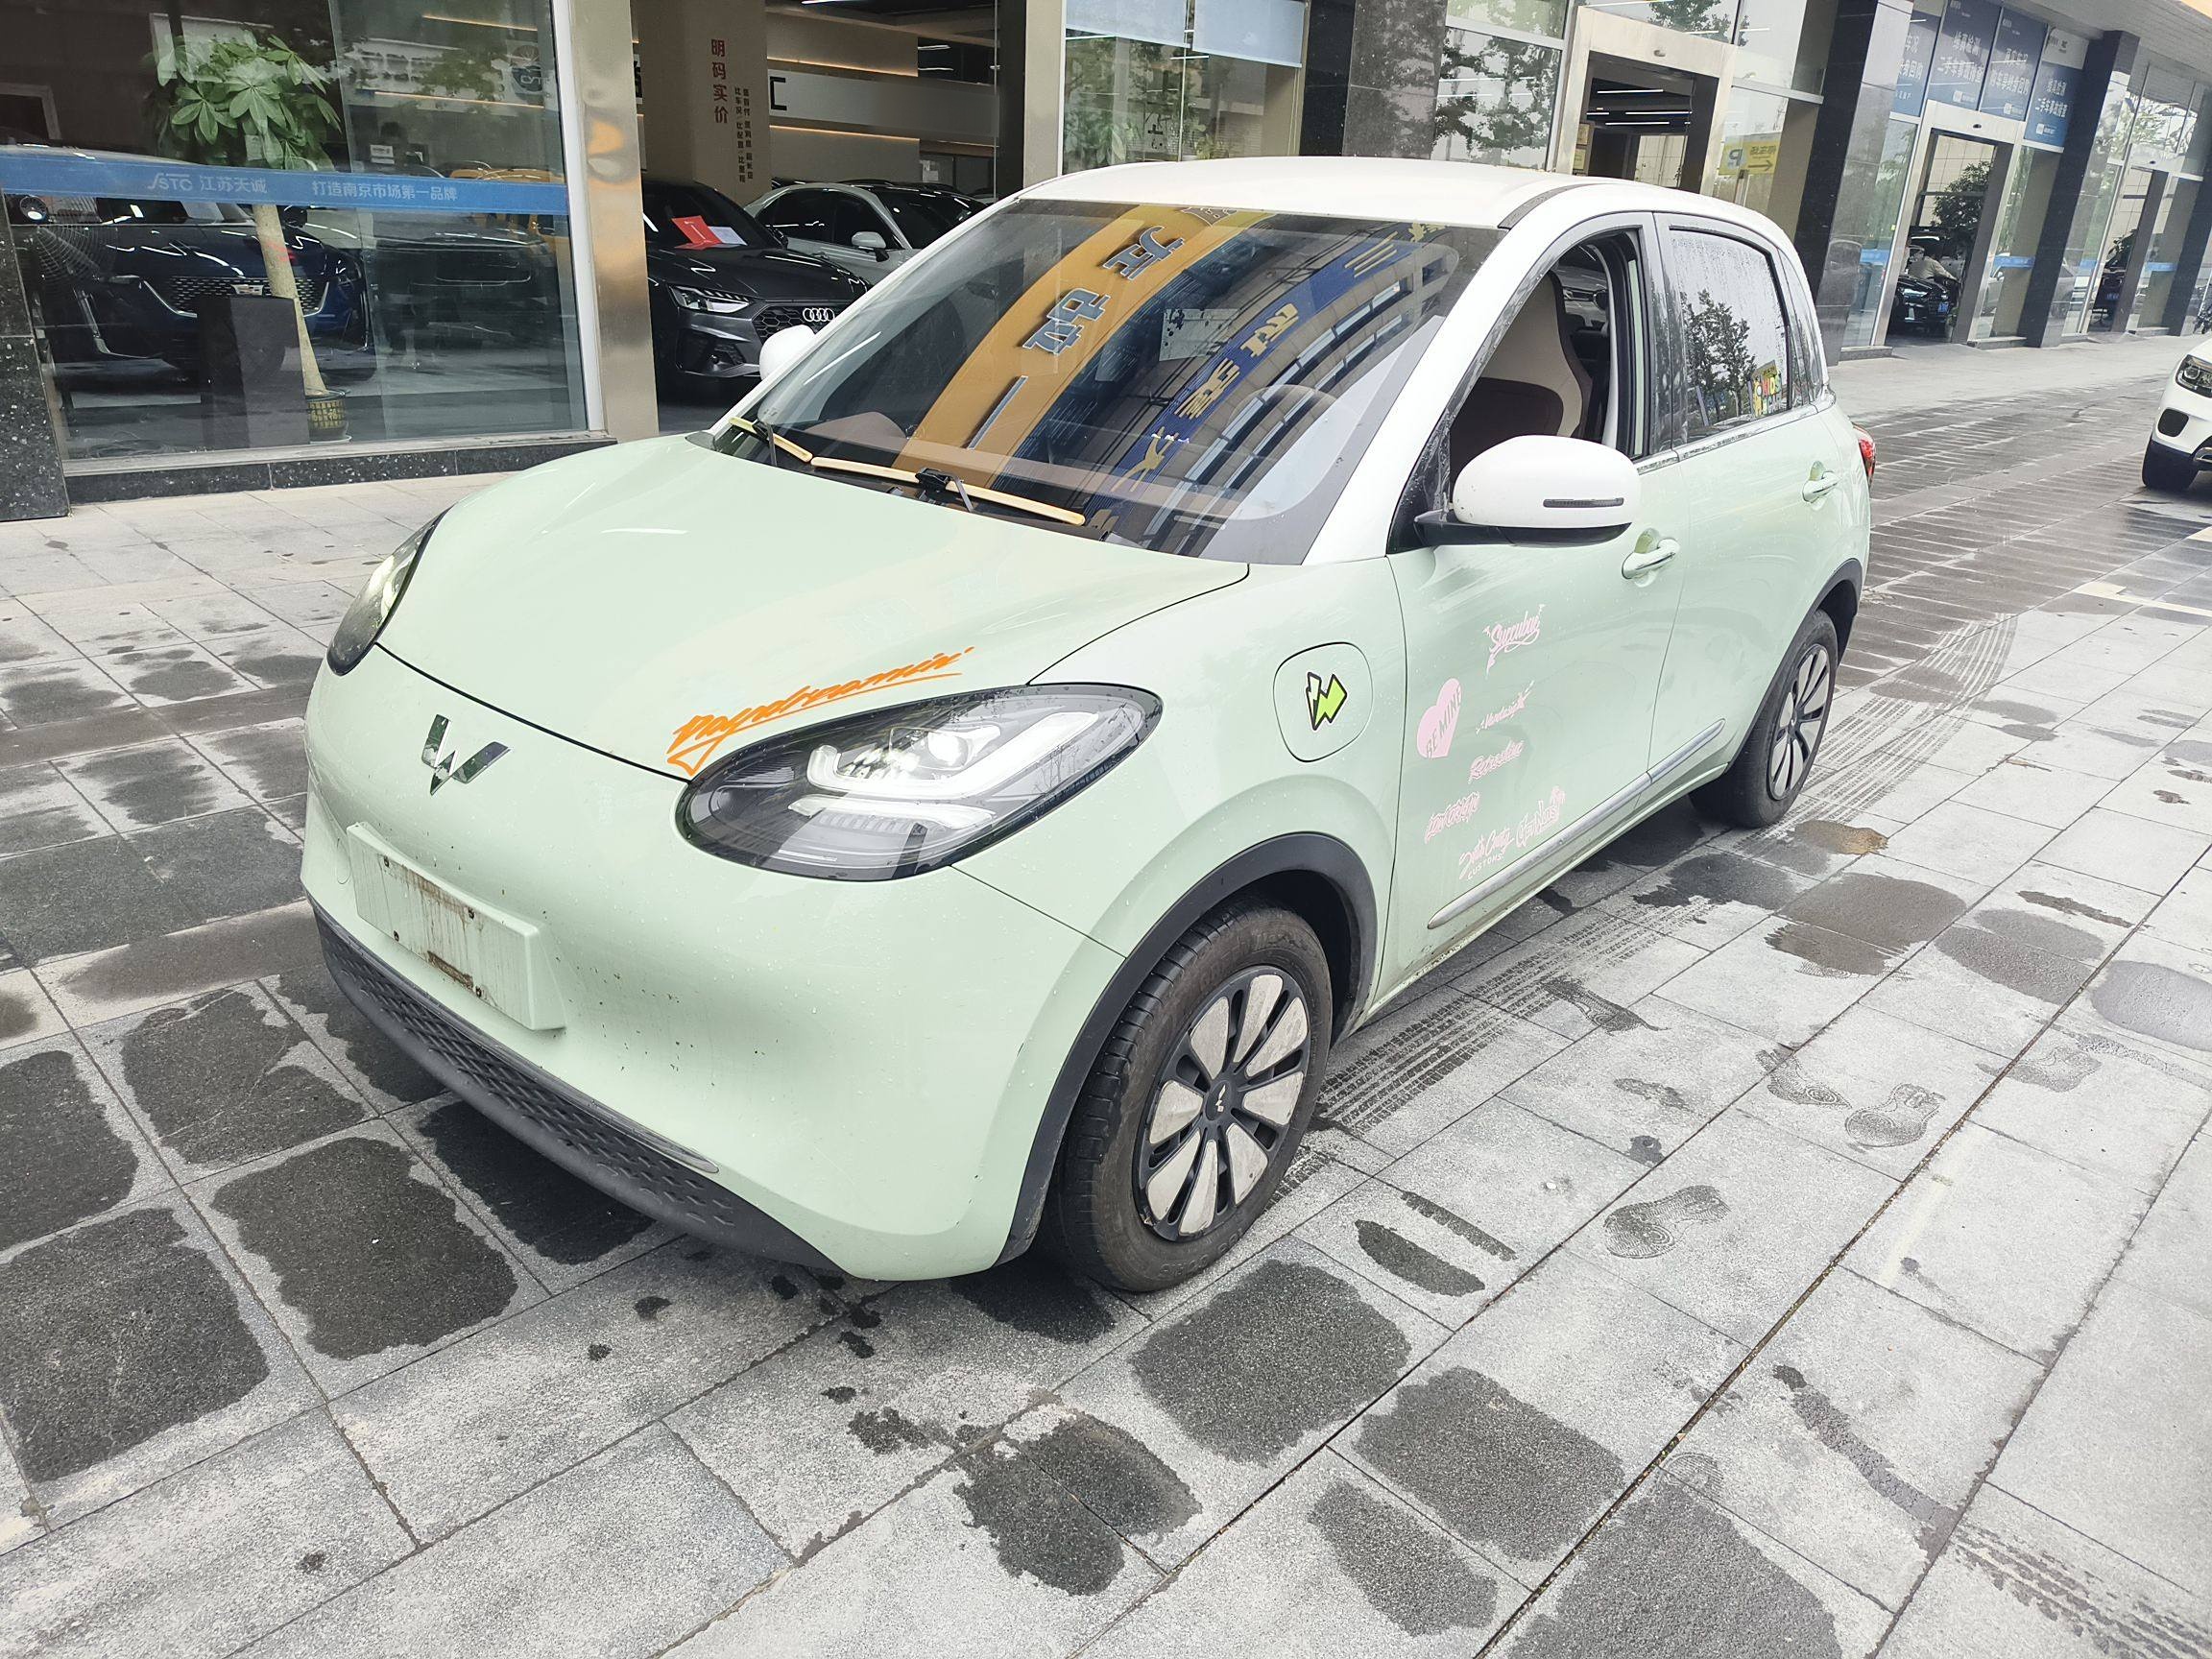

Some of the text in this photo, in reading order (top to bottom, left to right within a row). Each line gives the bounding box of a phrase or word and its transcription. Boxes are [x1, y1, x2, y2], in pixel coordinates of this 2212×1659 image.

[710, 38, 729, 124] 明码实价
[200, 175, 268, 193] 江苏天诚
[312, 180, 458, 201] 打造南京市场第一品牌
